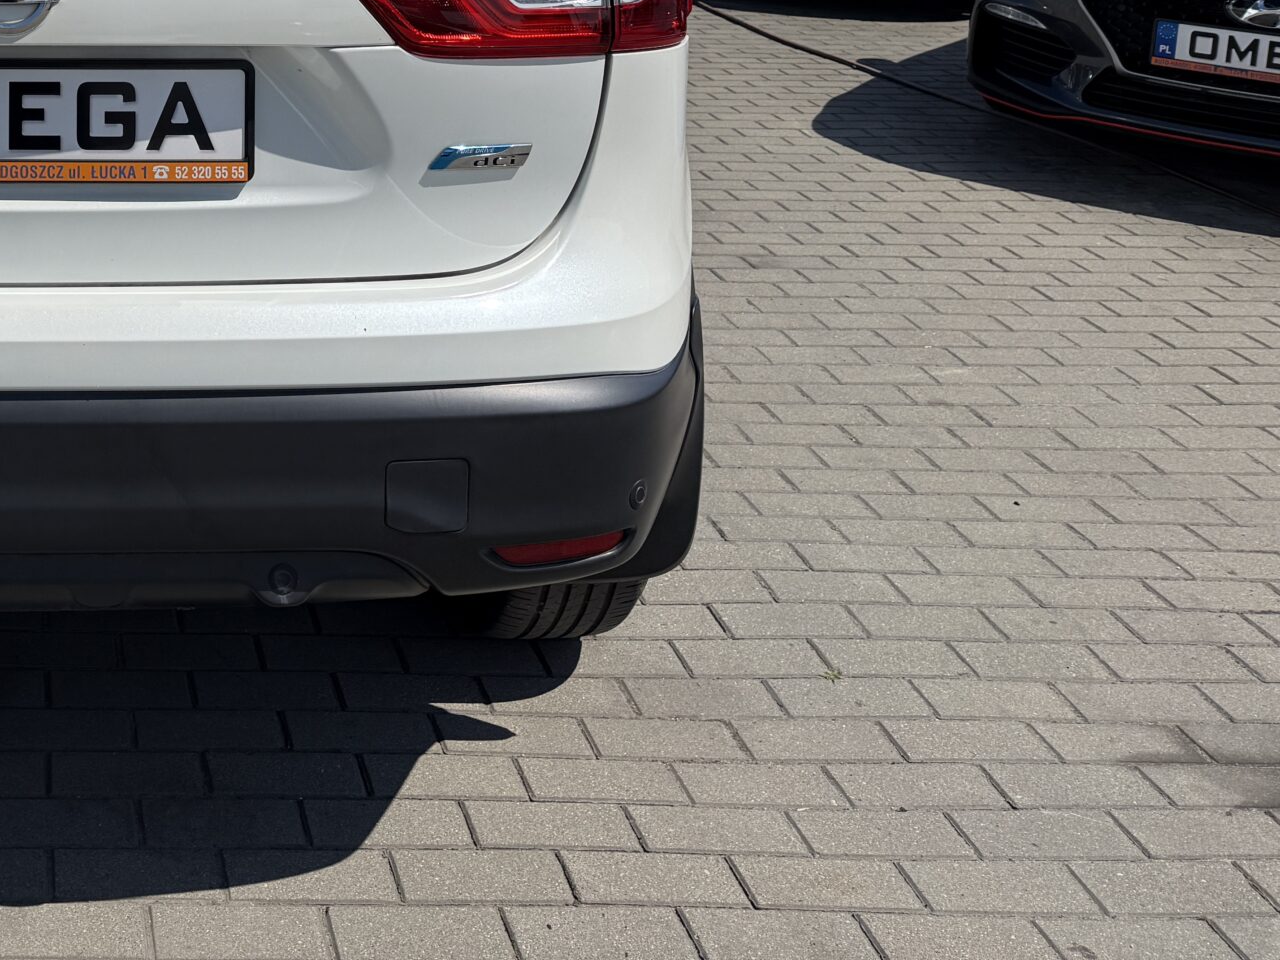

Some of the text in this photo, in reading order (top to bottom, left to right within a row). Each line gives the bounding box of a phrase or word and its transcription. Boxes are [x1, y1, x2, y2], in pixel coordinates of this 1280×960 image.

[1159, 44, 1172, 55] PL
[68, 165, 86, 179] ul.
[90, 165, 137, 179] ŁUCKA
[141, 166, 148, 179] 1
[175, 166, 189, 179] 52
[191, 166, 212, 179] 320
[215, 166, 229, 179] 55
[231, 166, 245, 179] 55
